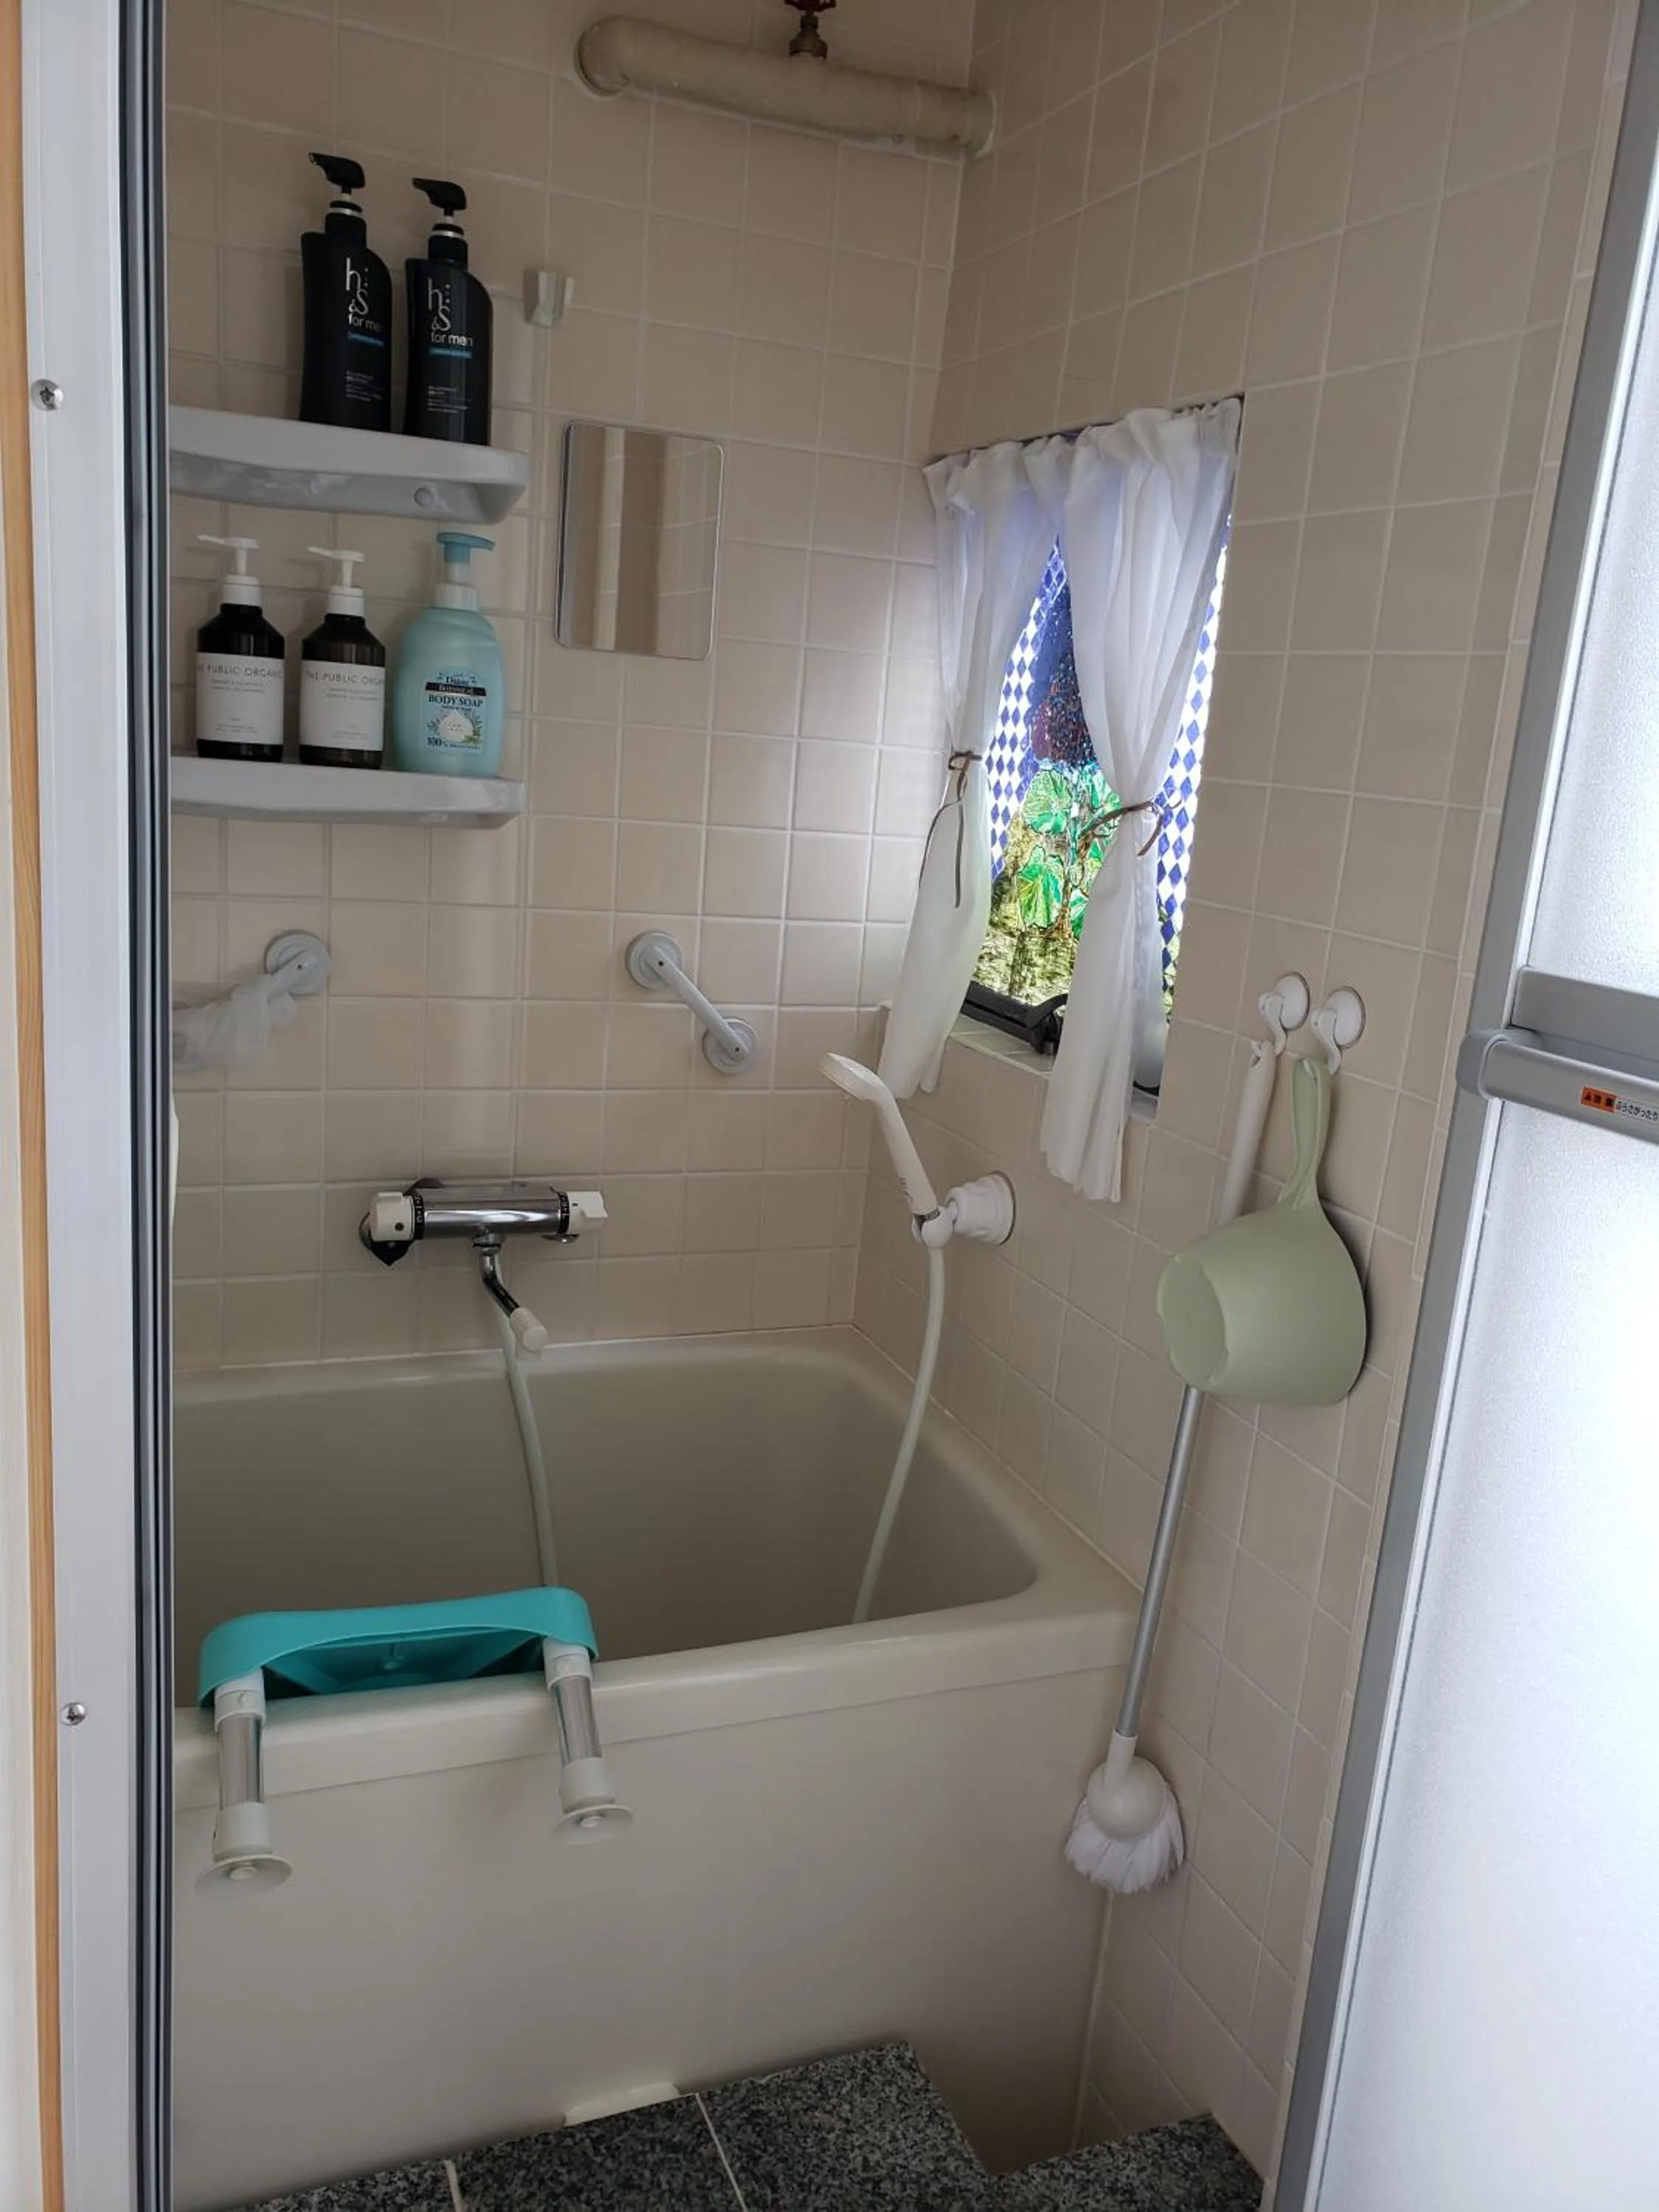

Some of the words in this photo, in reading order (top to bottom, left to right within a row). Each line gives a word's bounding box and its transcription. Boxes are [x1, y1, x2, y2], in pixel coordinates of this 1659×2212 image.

[430, 332, 447, 344] for
[448, 333, 473, 347] men
[322, 672, 357, 684] PUBLIC
[428, 695, 458, 705] BODY
[459, 696, 483, 707] SOAP
